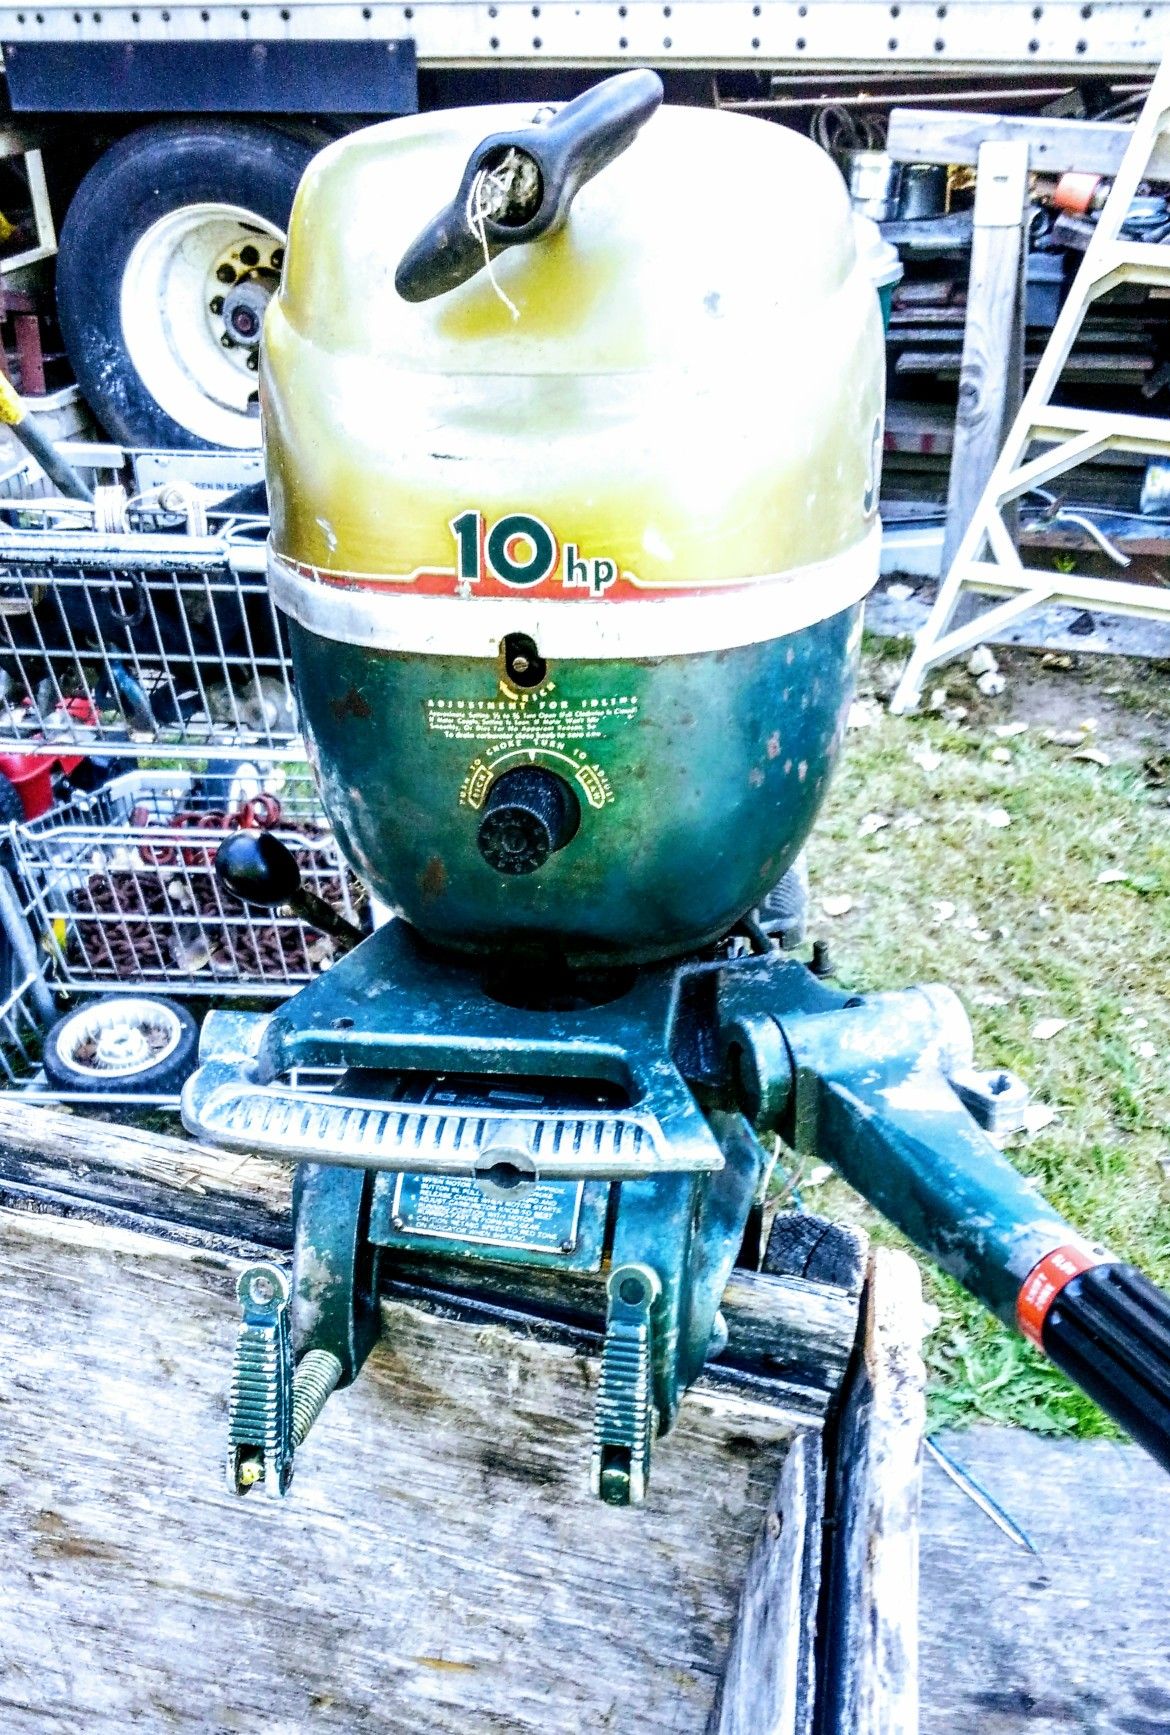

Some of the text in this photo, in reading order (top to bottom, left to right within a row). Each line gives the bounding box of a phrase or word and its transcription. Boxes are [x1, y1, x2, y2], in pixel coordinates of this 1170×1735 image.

[449, 509, 618, 597] 10 hp
[428, 696, 638, 710] ADJUSTMENT FOR IDLING
[485, 739, 523, 756] CHOKE
[533, 738, 566, 750] TURN
[420, 1183, 449, 1191] BUTTON
